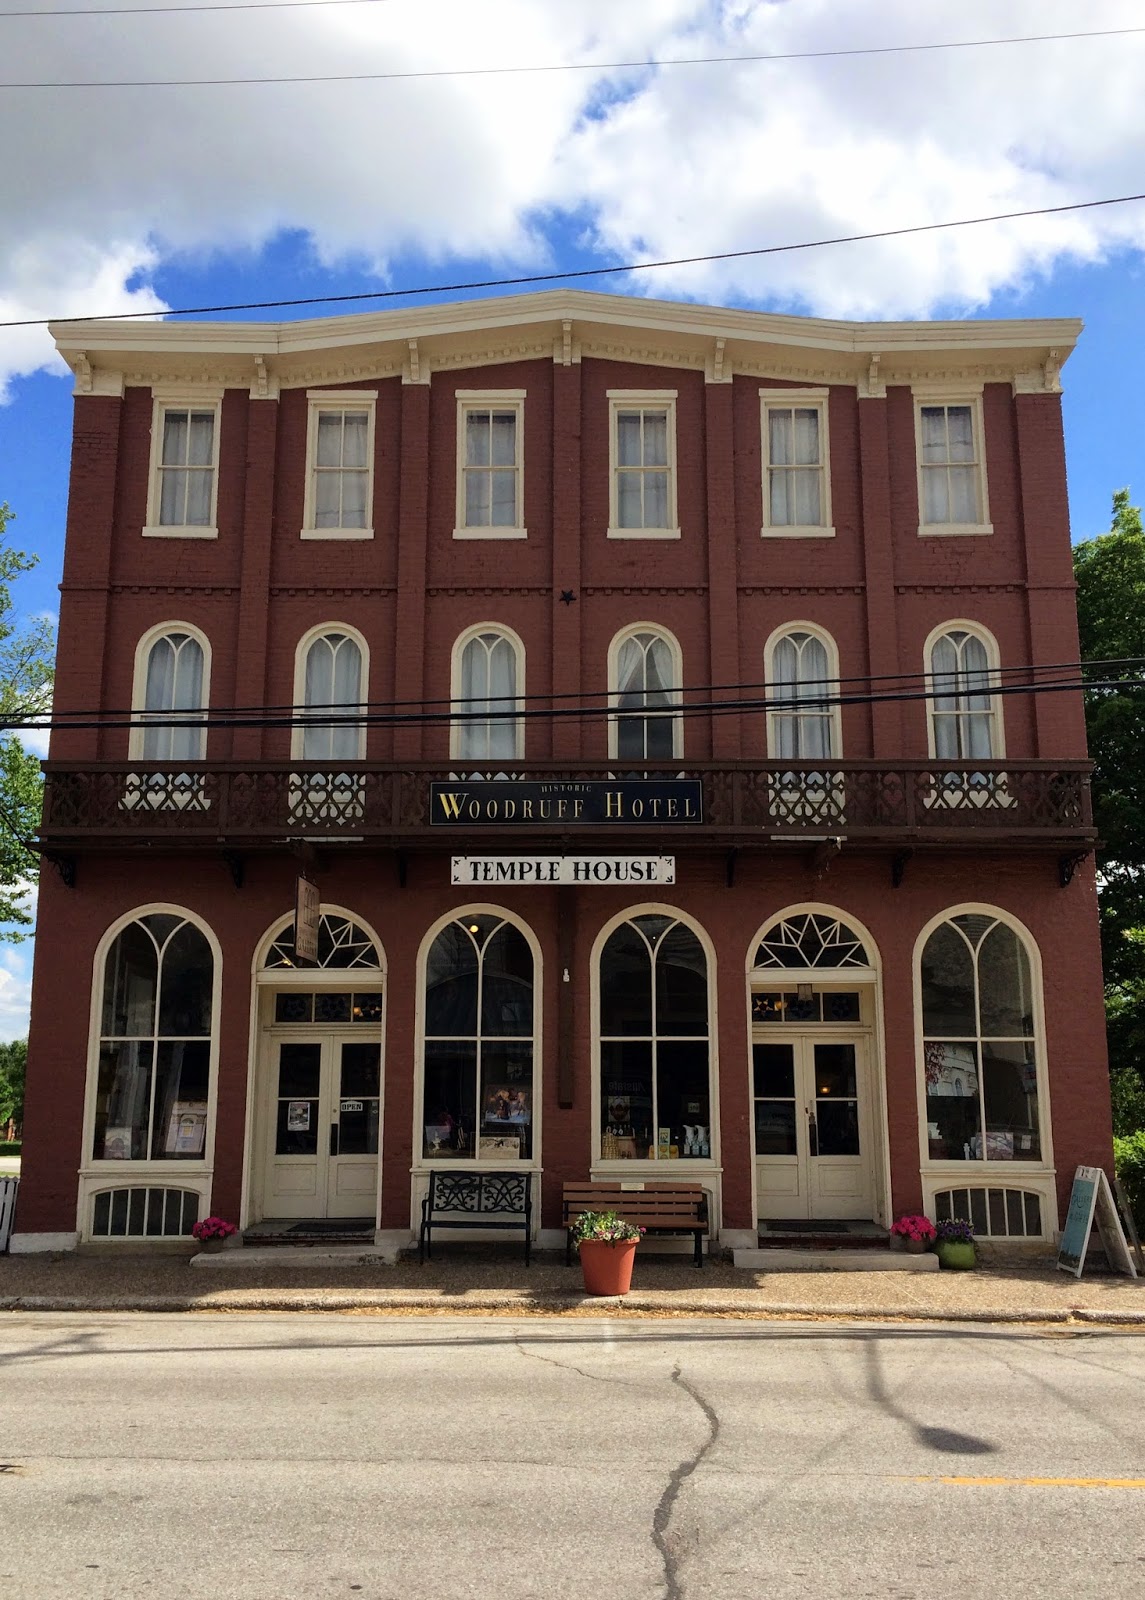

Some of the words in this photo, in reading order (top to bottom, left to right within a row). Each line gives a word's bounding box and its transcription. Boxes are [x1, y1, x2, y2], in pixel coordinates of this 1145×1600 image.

[541, 785, 592, 793] HISTORIC
[438, 793, 584, 819] WOODRUFF
[605, 792, 697, 818] HOTEL
[469, 861, 561, 881] TEMPLE
[572, 861, 658, 881] HOUSE
